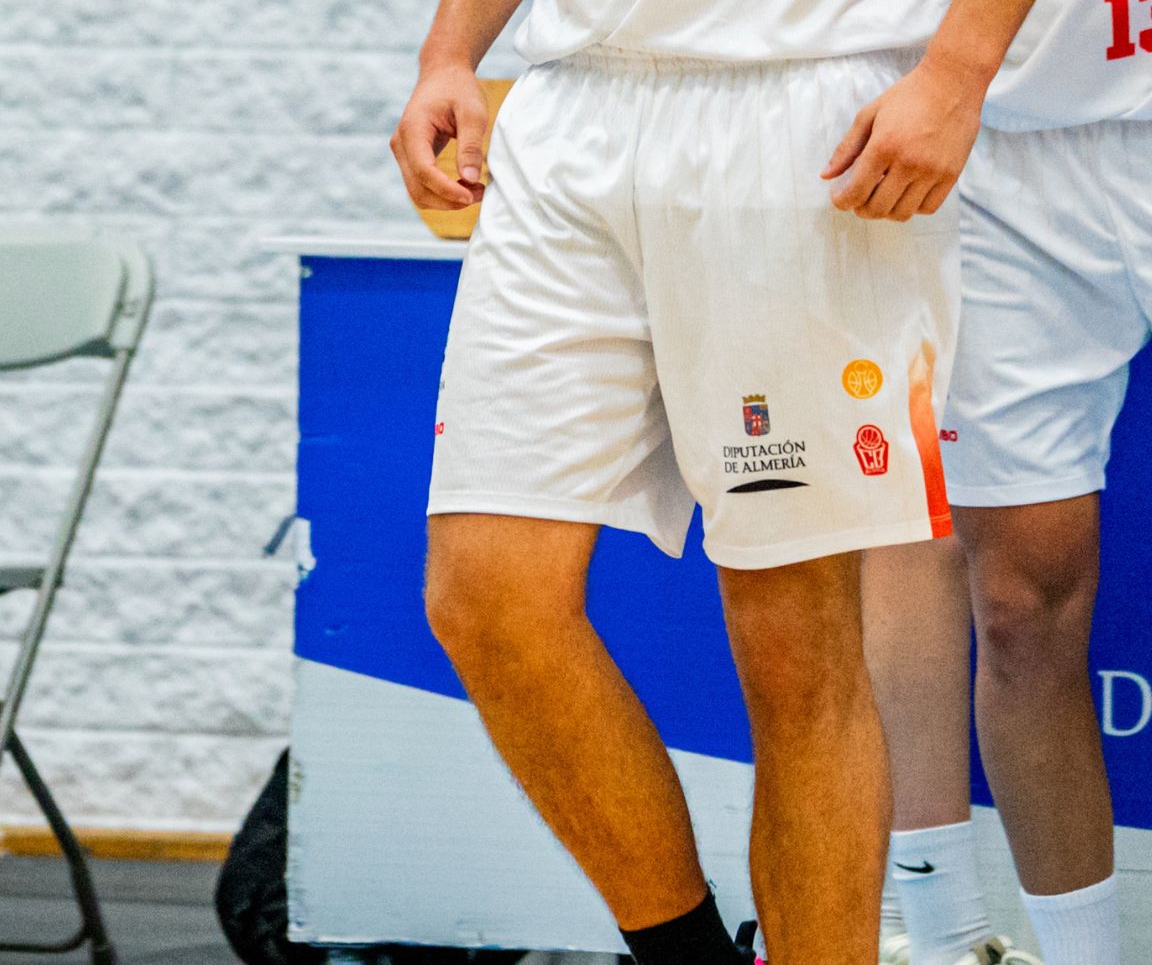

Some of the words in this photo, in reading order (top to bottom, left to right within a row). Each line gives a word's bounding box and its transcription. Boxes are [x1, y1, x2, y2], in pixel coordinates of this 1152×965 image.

[723, 439, 806, 459] DIPUTACIÓN
[724, 461, 739, 474] DE
[742, 454, 806, 474] ALMERÍA
